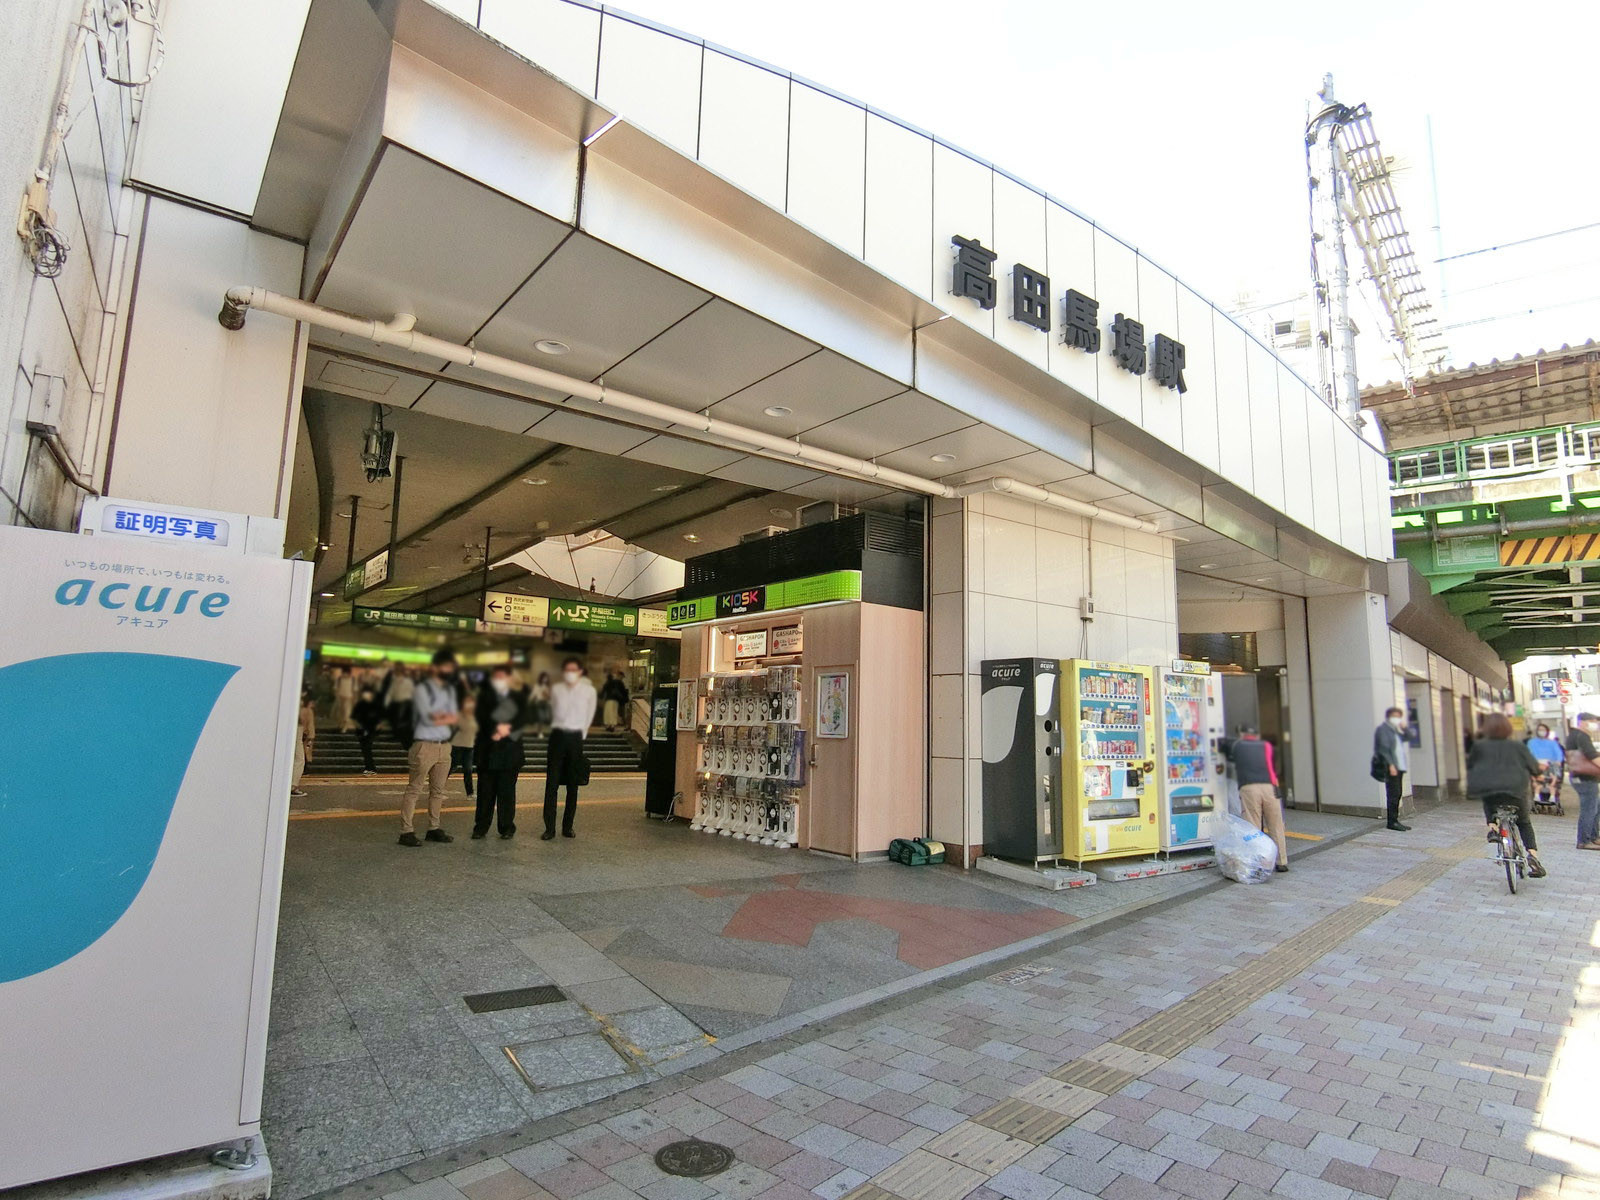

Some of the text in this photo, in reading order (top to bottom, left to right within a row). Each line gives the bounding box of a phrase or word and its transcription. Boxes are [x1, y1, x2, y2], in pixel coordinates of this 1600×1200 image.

[951, 234, 1188, 394] 高田馬場駅
[115, 510, 217, 541] 証明写真
[64, 559, 230, 585] いつもの場所で、いつもは変わる。
[54, 578, 231, 618] acure
[722, 590, 759, 609] KIOSK
[364, 610, 381, 619] JR
[567, 605, 590, 619] JR
[116, 616, 169, 628] アキュア
[991, 667, 1021, 678] acure
